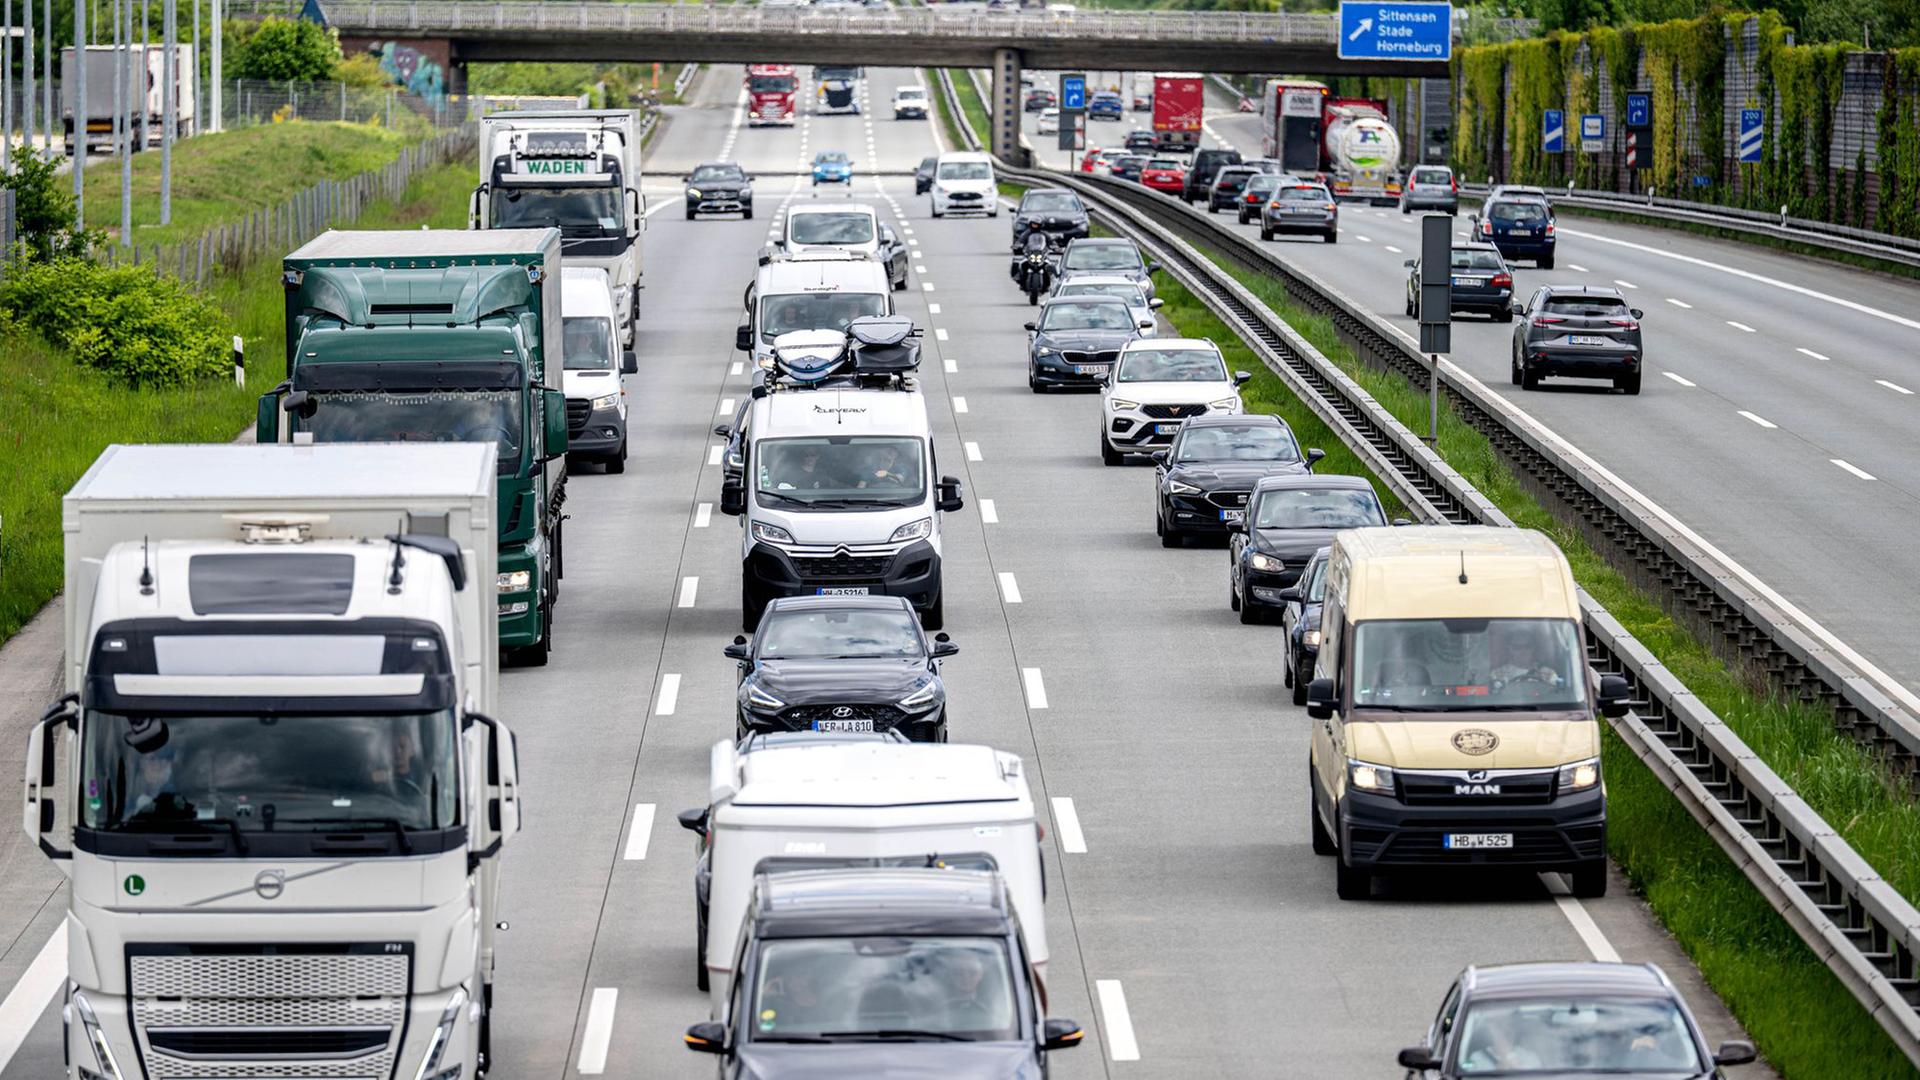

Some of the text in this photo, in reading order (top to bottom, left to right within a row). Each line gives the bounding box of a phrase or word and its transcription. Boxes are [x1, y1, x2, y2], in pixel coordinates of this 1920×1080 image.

[1378, 9, 1437, 22] Sittensen
[1377, 25, 1413, 37] Stade
[1376, 40, 1443, 55] Horneburg
[1744, 112, 1759, 120] 200
[527, 161, 585, 174] WADEN
[855, 721, 872, 732] 810
[1455, 785, 1500, 795] MAN
[1454, 835, 1508, 846] HB W 525
[129, 877, 141, 893] L
